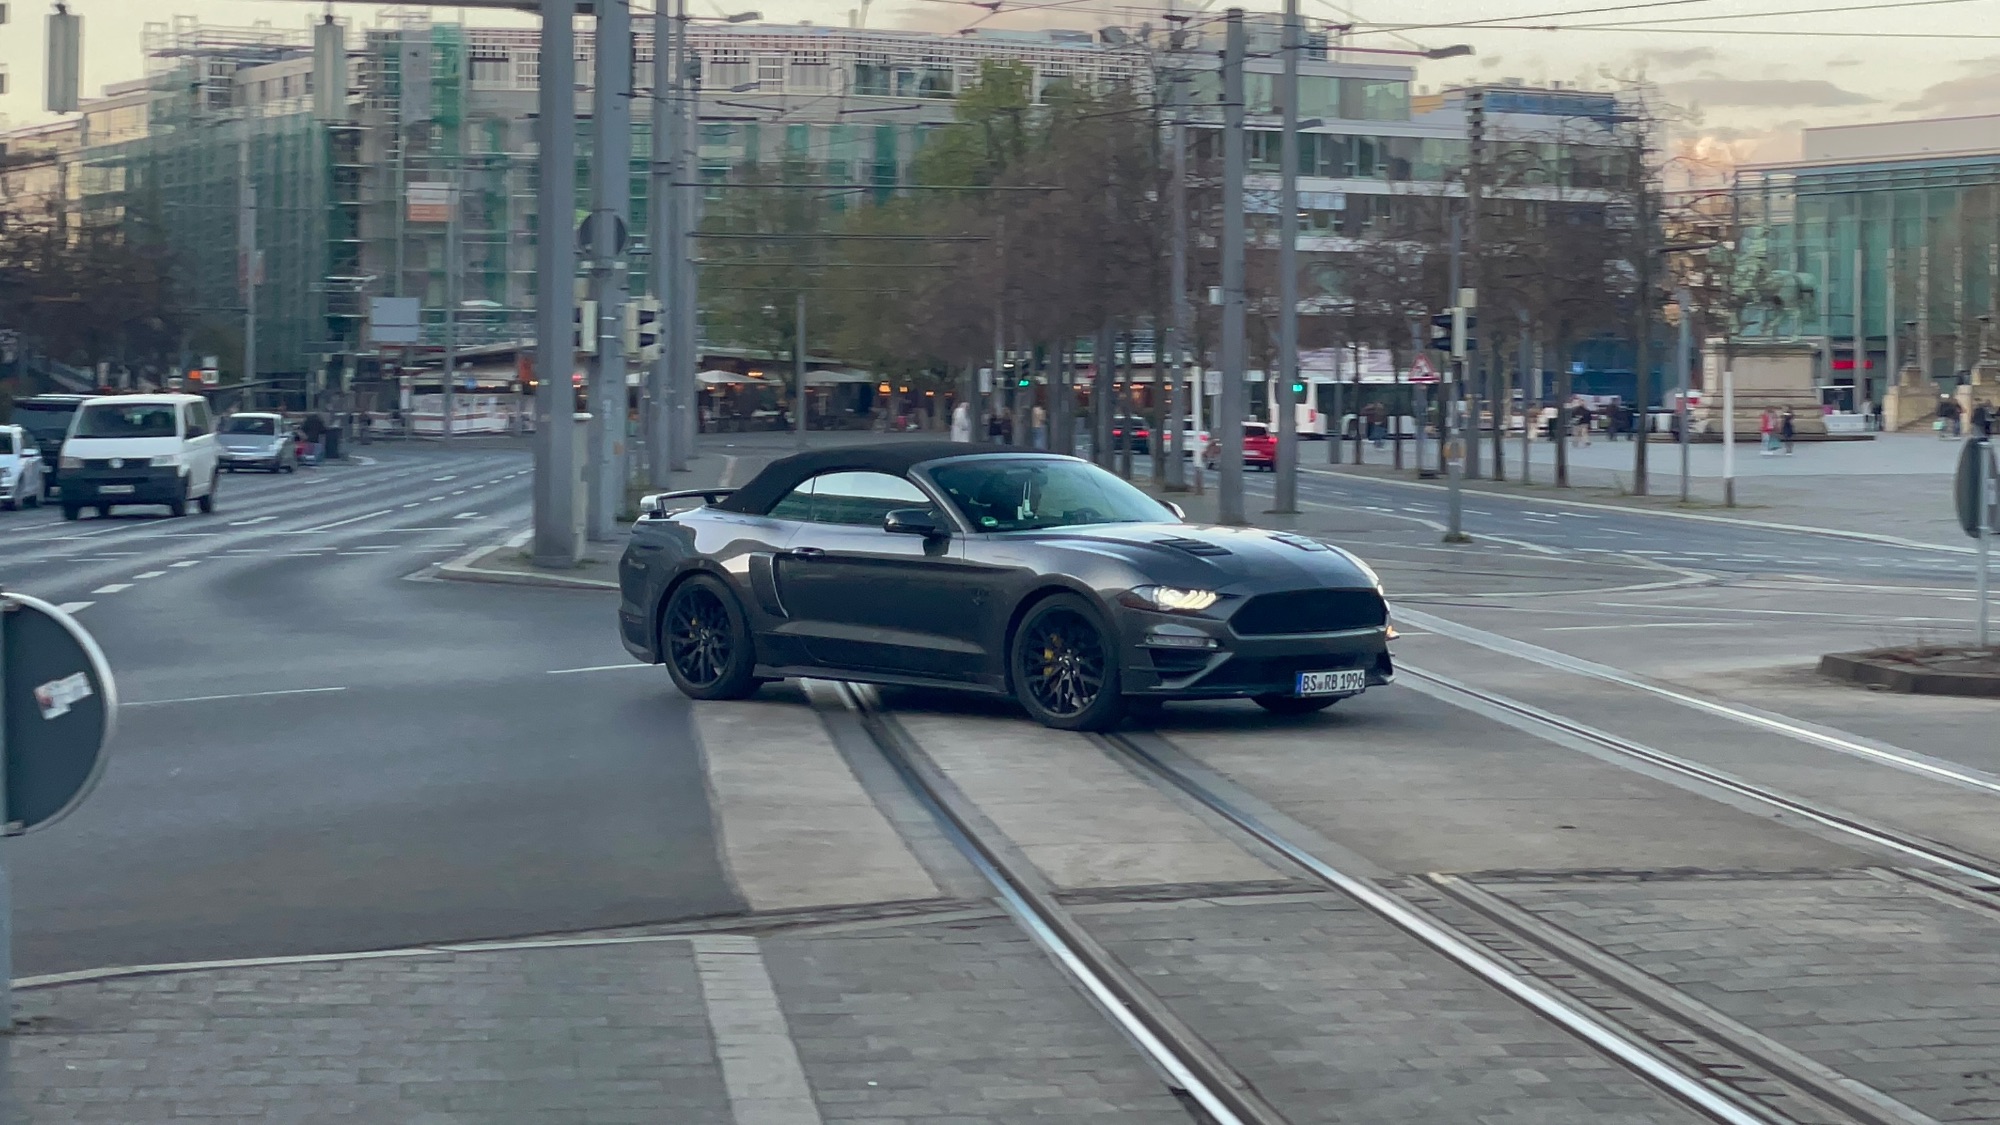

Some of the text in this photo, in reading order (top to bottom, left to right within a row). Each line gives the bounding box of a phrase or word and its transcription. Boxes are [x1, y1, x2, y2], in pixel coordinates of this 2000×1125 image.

[1303, 672, 1364, 691] BS RB 1996
